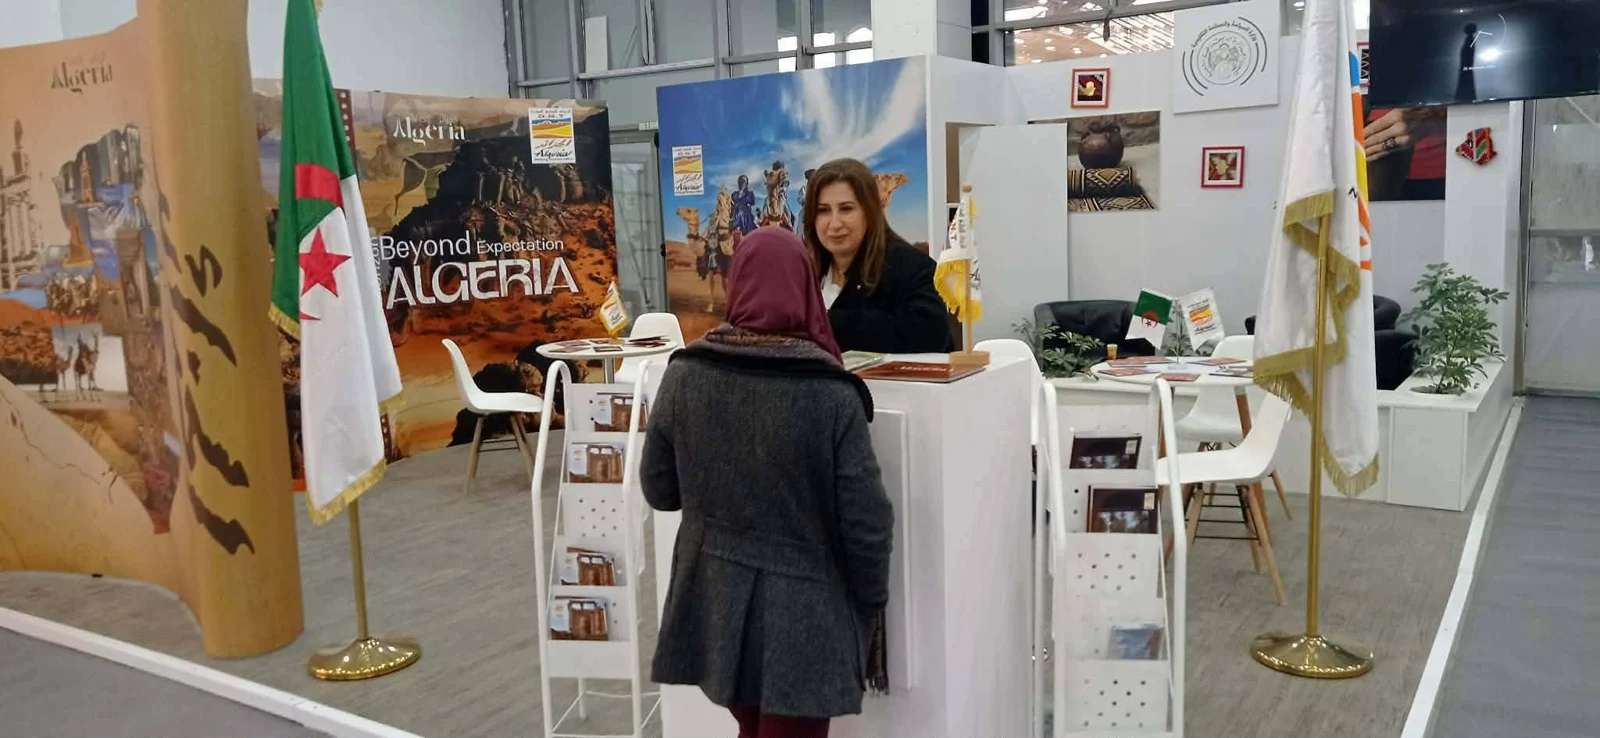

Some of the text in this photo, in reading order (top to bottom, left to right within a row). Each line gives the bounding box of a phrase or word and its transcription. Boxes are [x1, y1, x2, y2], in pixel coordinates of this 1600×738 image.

[51, 61, 113, 94] Algeria
[393, 116, 465, 146] Algeria
[379, 230, 564, 264] Beyond Expectation
[386, 256, 580, 310] ALGERIA
